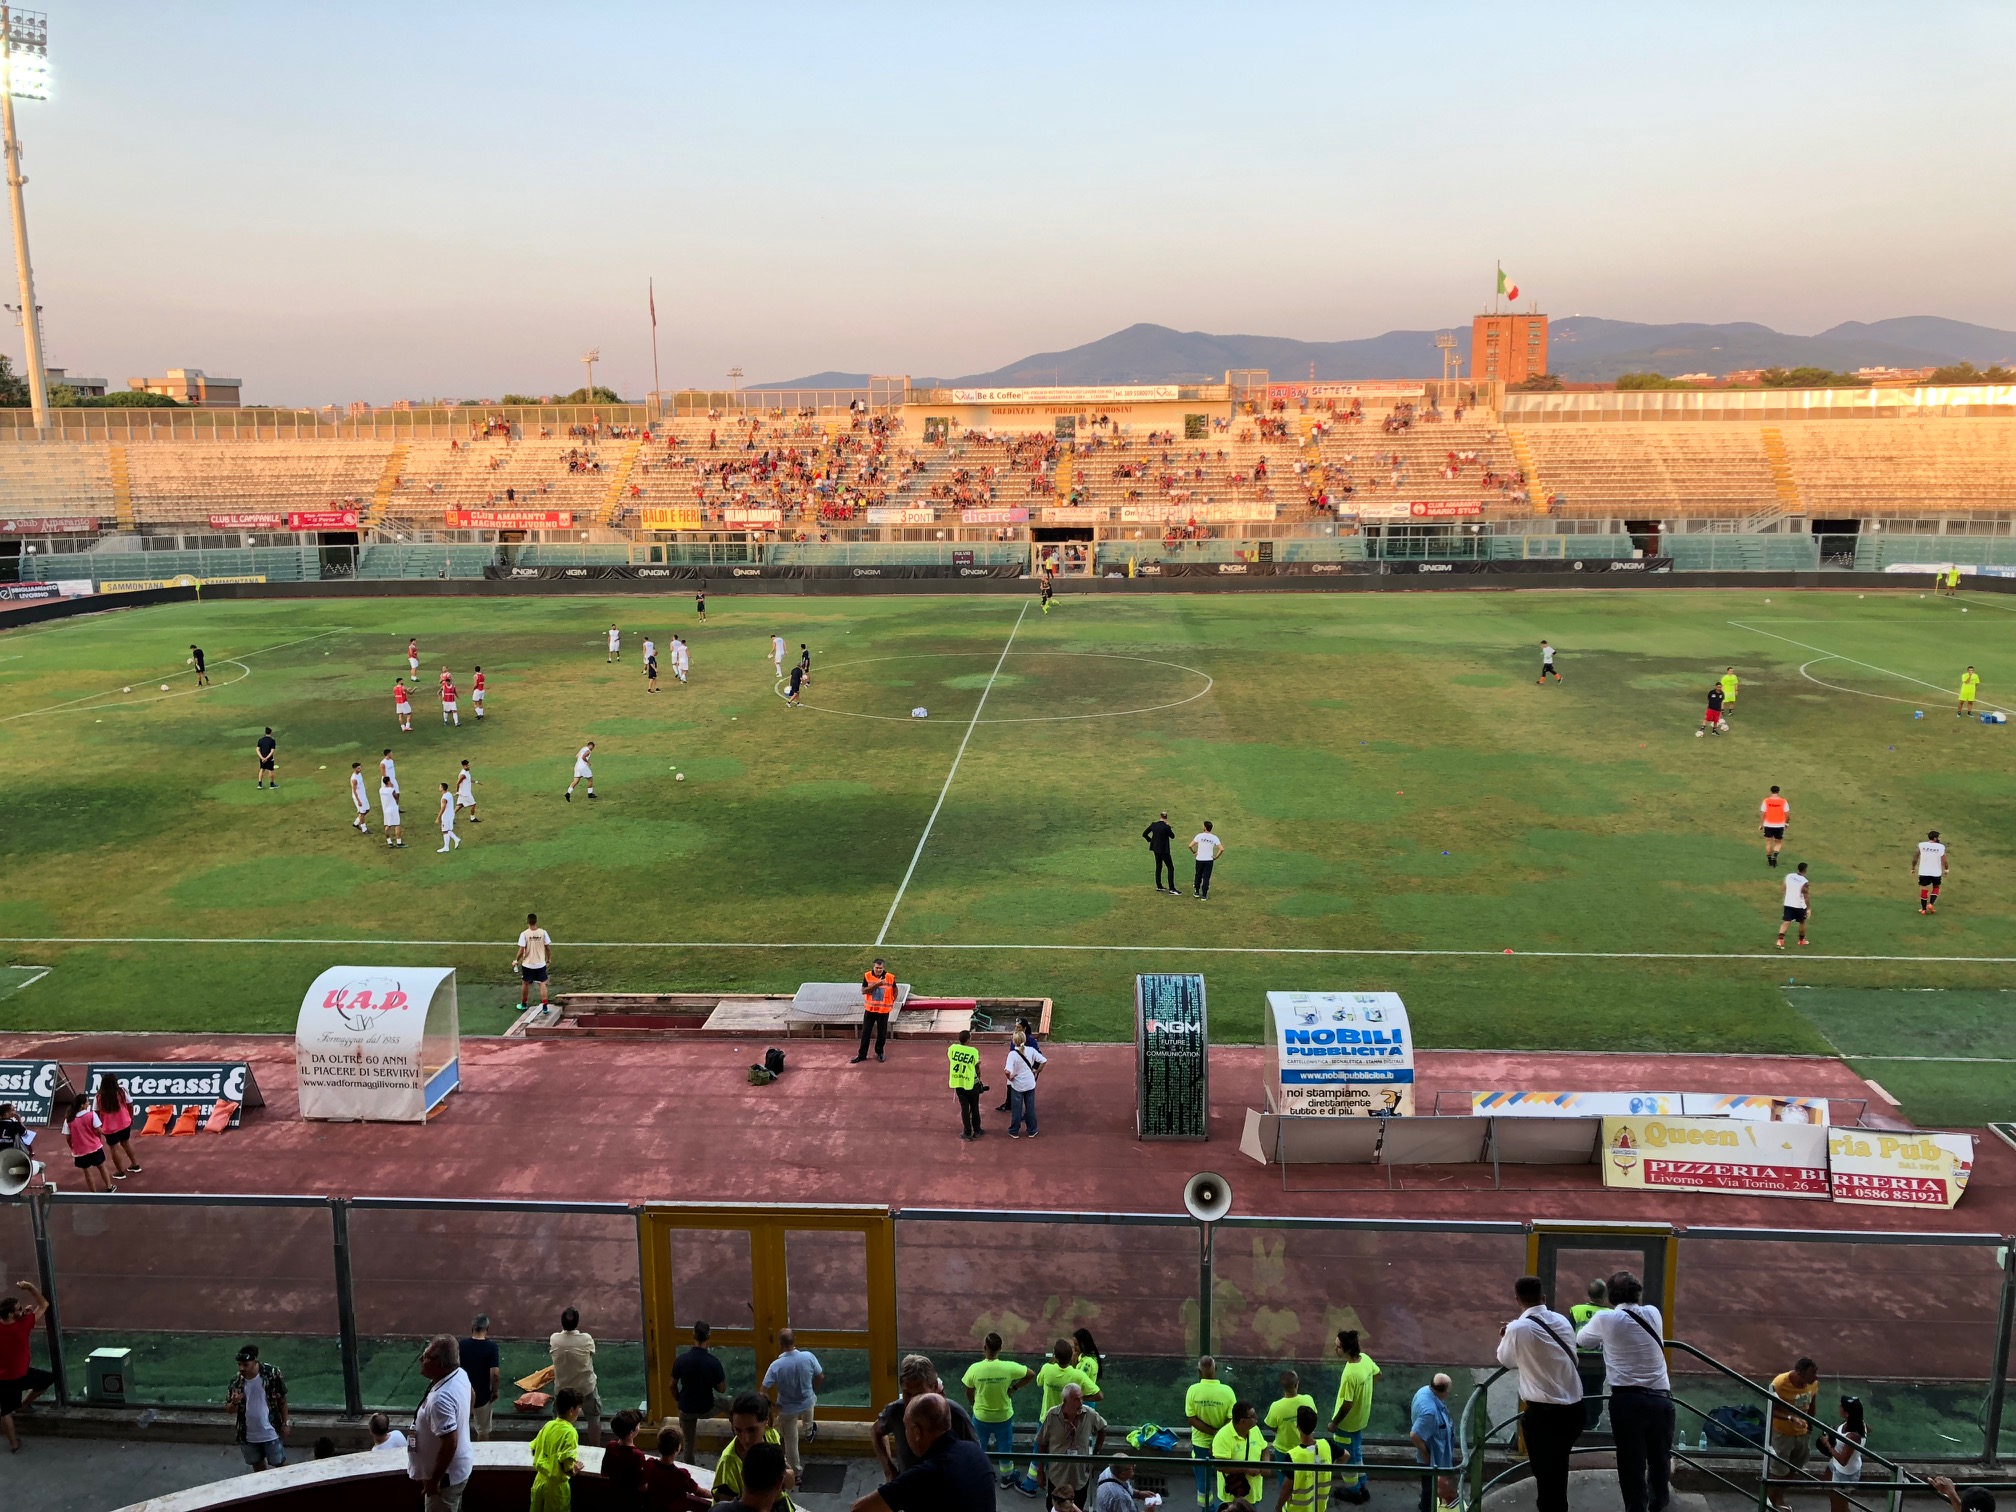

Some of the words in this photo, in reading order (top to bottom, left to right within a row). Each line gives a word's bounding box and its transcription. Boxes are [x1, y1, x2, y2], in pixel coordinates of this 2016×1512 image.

[977, 392, 987, 400] Be
[989, 392, 995, 400] &
[996, 391, 1021, 400] Coffee
[992, 407, 1035, 415] GRADINATA
[470, 511, 494, 520] CLUB
[496, 512, 546, 520] AMARANTO
[642, 509, 668, 523] BALDI
[671, 509, 676, 523] E
[679, 509, 700, 523] FIERI
[900, 510, 907, 523] 3
[908, 513, 933, 522] PONTI
[962, 510, 1011, 523] dierre
[1457, 507, 1480, 515] STUA
[16, 519, 38, 528] Club
[42, 517, 90, 528] Amaranto
[210, 515, 230, 523] CLUB
[231, 514, 238, 523] IL
[239, 513, 280, 523] CAMPANILE
[519, 520, 557, 528] LIVORNO
[107, 581, 164, 591] SAMMONTANA
[1151, 1021, 1201, 1034] NGM
[366, 1033, 384, 1044] dal
[1284, 1028, 1403, 1045] NOBILI
[1286, 1045, 1404, 1056] PUBBLICITÀ
[311, 1054, 326, 1063] DA
[328, 1054, 363, 1064] OLTRE
[365, 1056, 379, 1065] 60
[382, 1056, 407, 1066] ANNI
[301, 1066, 311, 1075] IL
[313, 1066, 356, 1076] PIACERE
[359, 1067, 370, 1077] DI
[373, 1067, 419, 1078] SERVIRVI
[1300, 1071, 1395, 1081] www.nobilipubblicita.it
[303, 1079, 419, 1090] www.vadformaggilivorno.it
[1286, 1088, 1304, 1097] noi
[1306, 1088, 1371, 1102] stampiamo.
[1308, 1098, 1372, 1107] direttamente
[1290, 1107, 1317, 1115] tutto
[1327, 1107, 1336, 1115] di
[1644, 1121, 1739, 1148] Queen
[1877, 1137, 1942, 1161] Pub
[1649, 1160, 1776, 1180] PIZZERIA
[1650, 1173, 1703, 1186] Livorno
[1719, 1176, 1740, 1188] Via
[1792, 1180, 1809, 1191] 26
[1855, 1187, 1889, 1200] 0586
[1893, 1190, 1944, 1202] 851921
